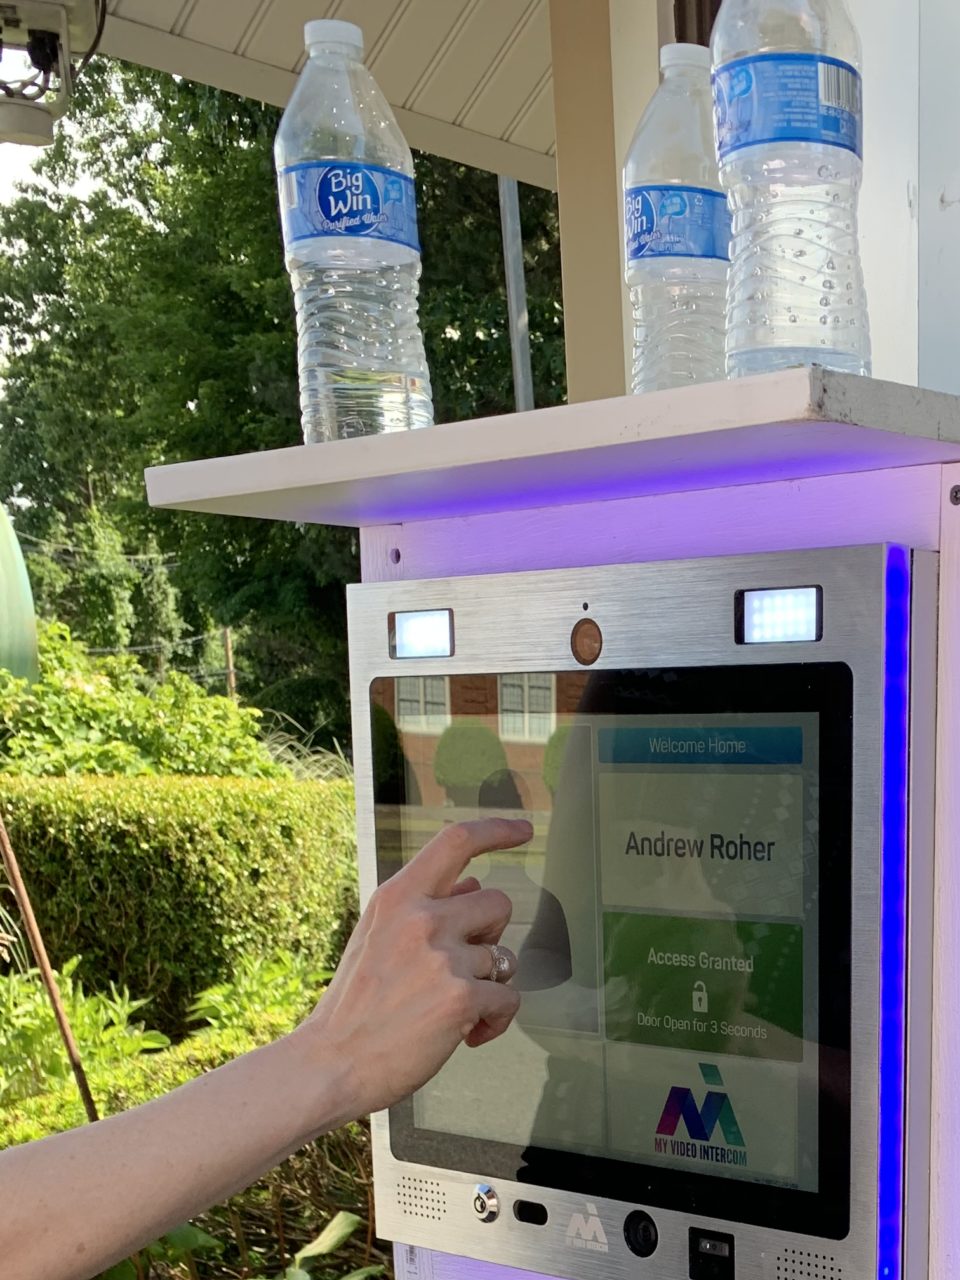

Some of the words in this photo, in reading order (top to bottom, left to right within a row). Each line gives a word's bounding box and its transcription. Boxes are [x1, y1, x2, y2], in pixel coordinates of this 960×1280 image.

[327, 169, 363, 194] Big
[328, 189, 372, 217] Win
[648, 736, 705, 754] Welcome
[708, 737, 746, 754] Home
[625, 831, 704, 859] Andrew
[710, 833, 775, 862] Roher
[647, 947, 696, 969] Access
[698, 951, 754, 973] Granted
[637, 1012, 661, 1029] Door
[663, 1014, 691, 1034] Open
[692, 1017, 708, 1032] for
[710, 1019, 718, 1034] 3
[720, 1020, 768, 1040] Seconds
[654, 1137, 668, 1154] MY
[670, 1140, 697, 1159] VIDEO
[699, 1144, 748, 1167] INTERCOM
